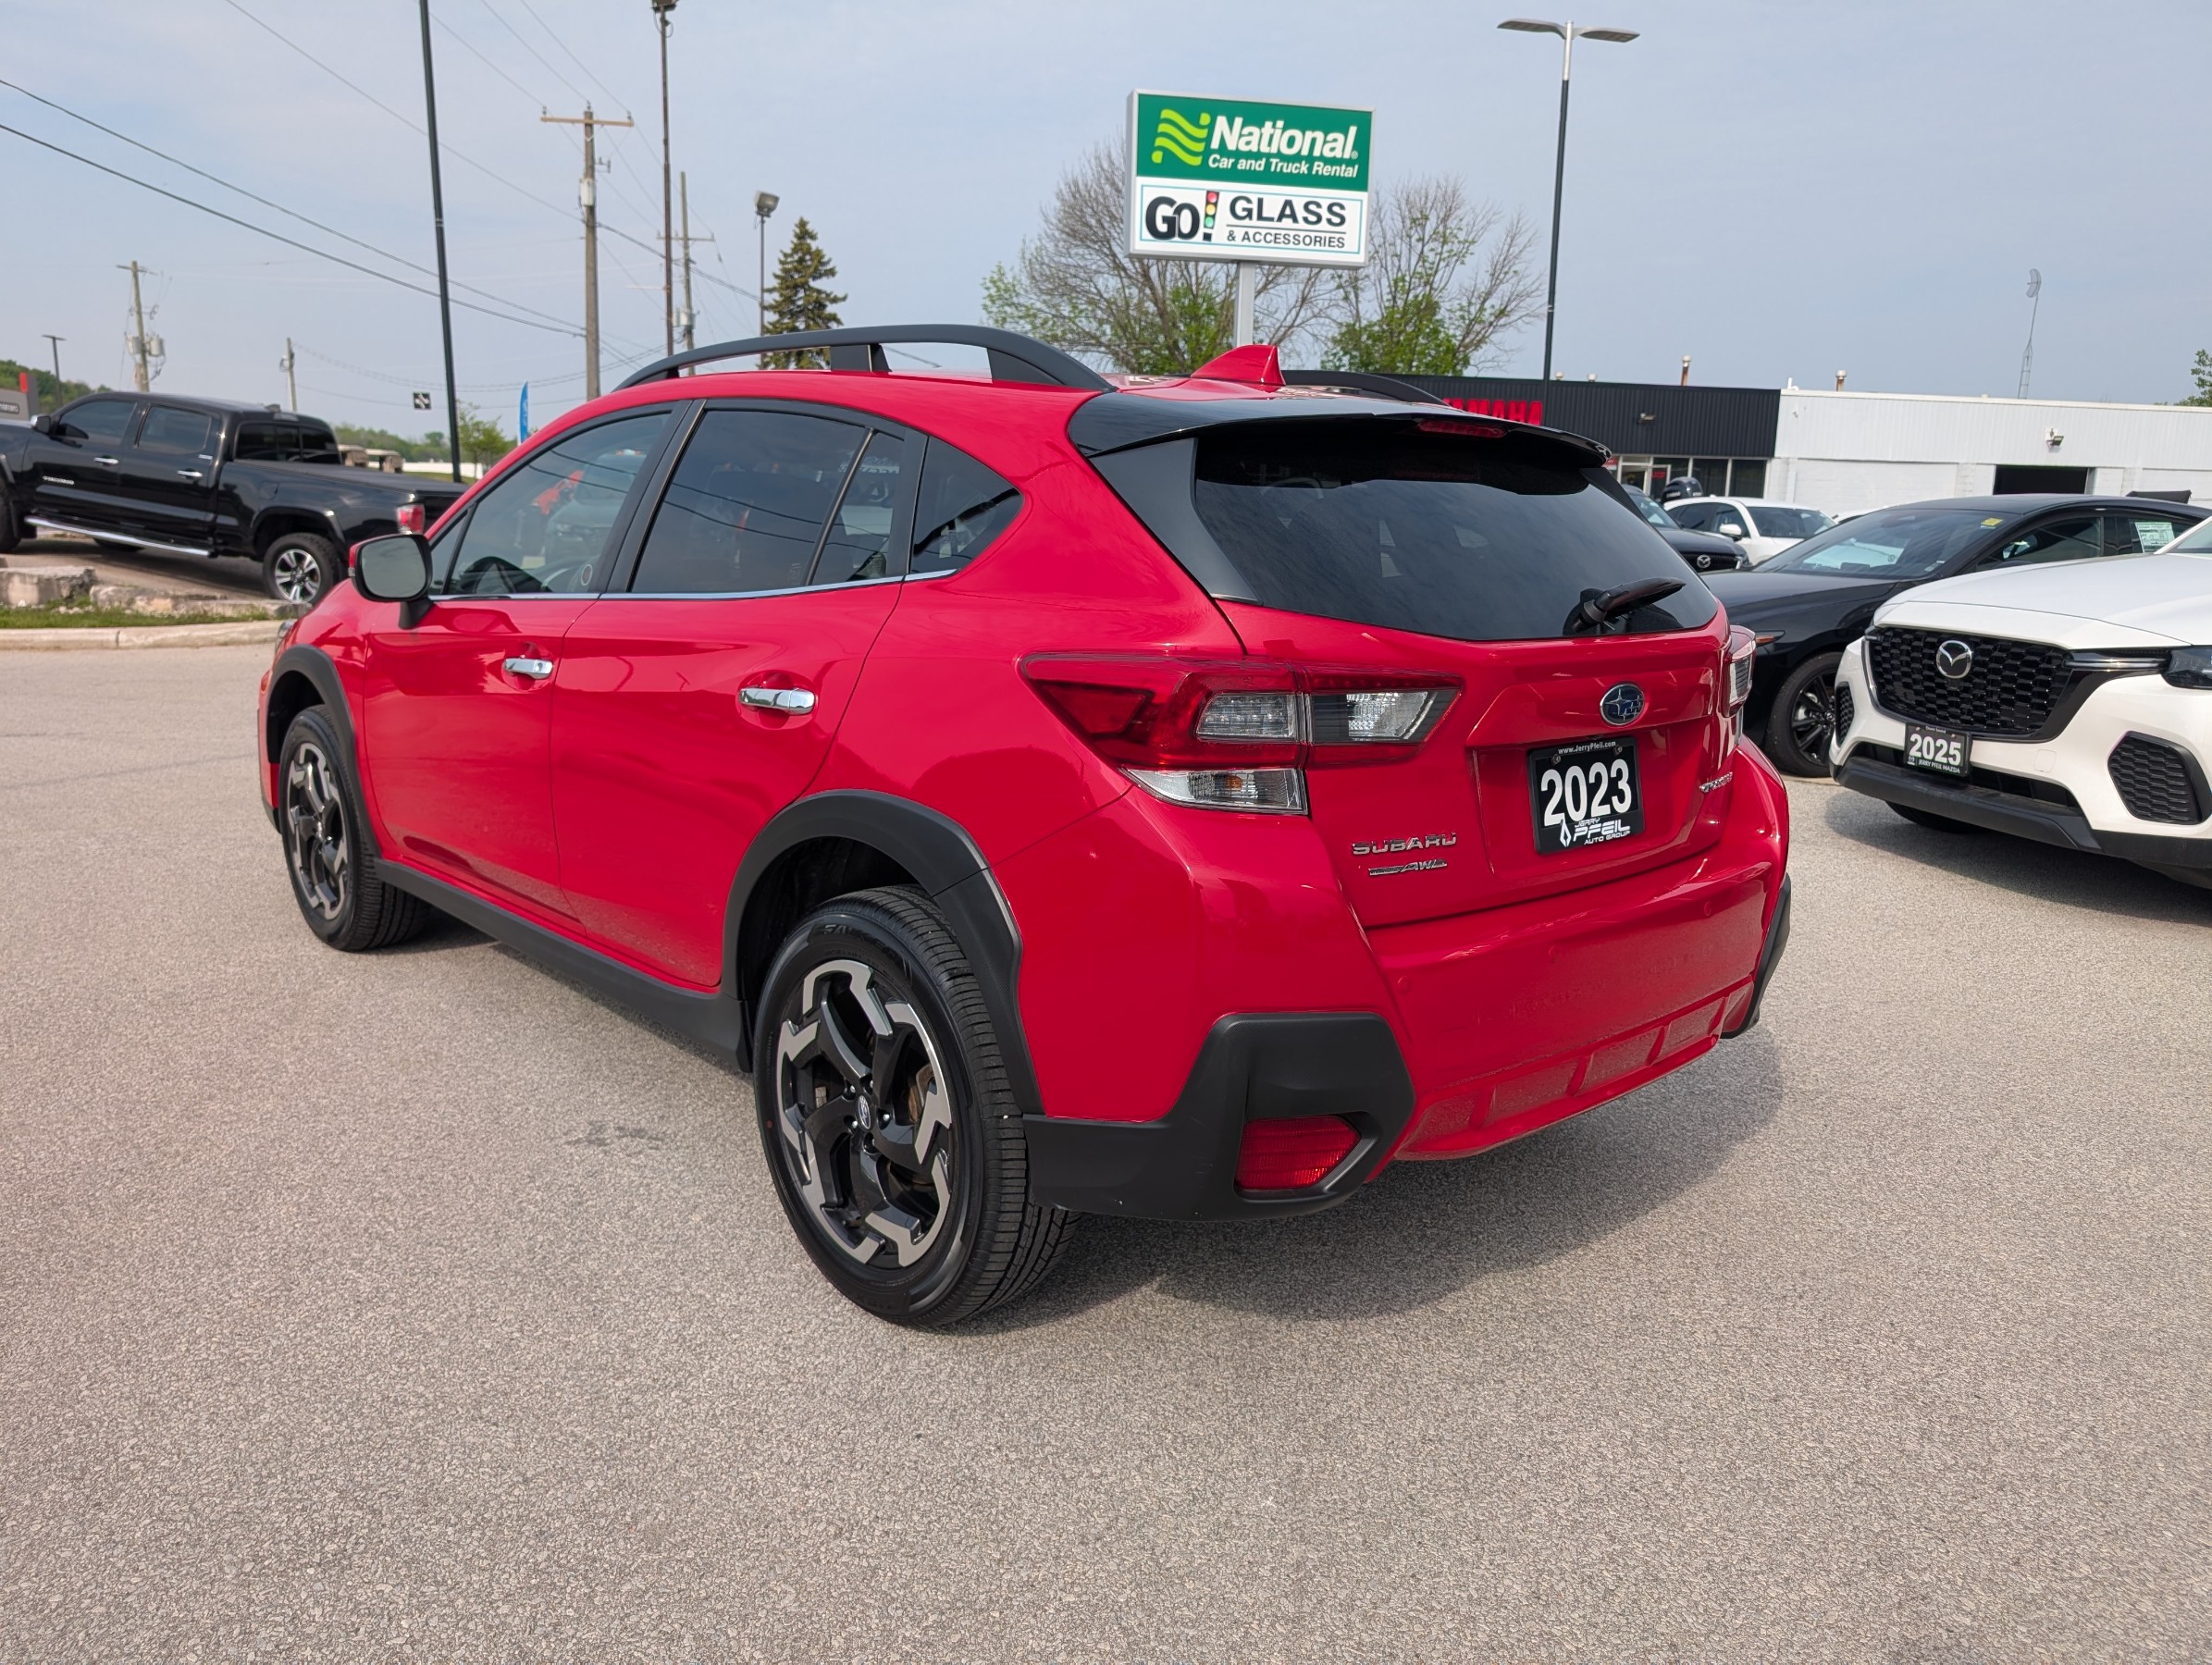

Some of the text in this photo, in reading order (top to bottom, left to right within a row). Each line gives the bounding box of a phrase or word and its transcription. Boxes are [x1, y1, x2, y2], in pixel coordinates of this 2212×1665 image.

[1210, 116, 1357, 159] National
[1208, 154, 1358, 178] Car and Truck Rental
[1230, 195, 1346, 228] GLASS
[1227, 230, 1345, 248] & ACCESSORIES
[1558, 741, 1616, 755] www.JerryPfeil.com
[1909, 734, 1961, 766] 2025
[1943, 764, 1960, 773] MAZDA
[1541, 758, 1632, 826] 2023
[1573, 820, 1630, 842] PFEIL
[1575, 818, 1600, 828] JERRY
[1352, 832, 1457, 855] SUBARU
[1584, 831, 1630, 845] AUTO GROUP
